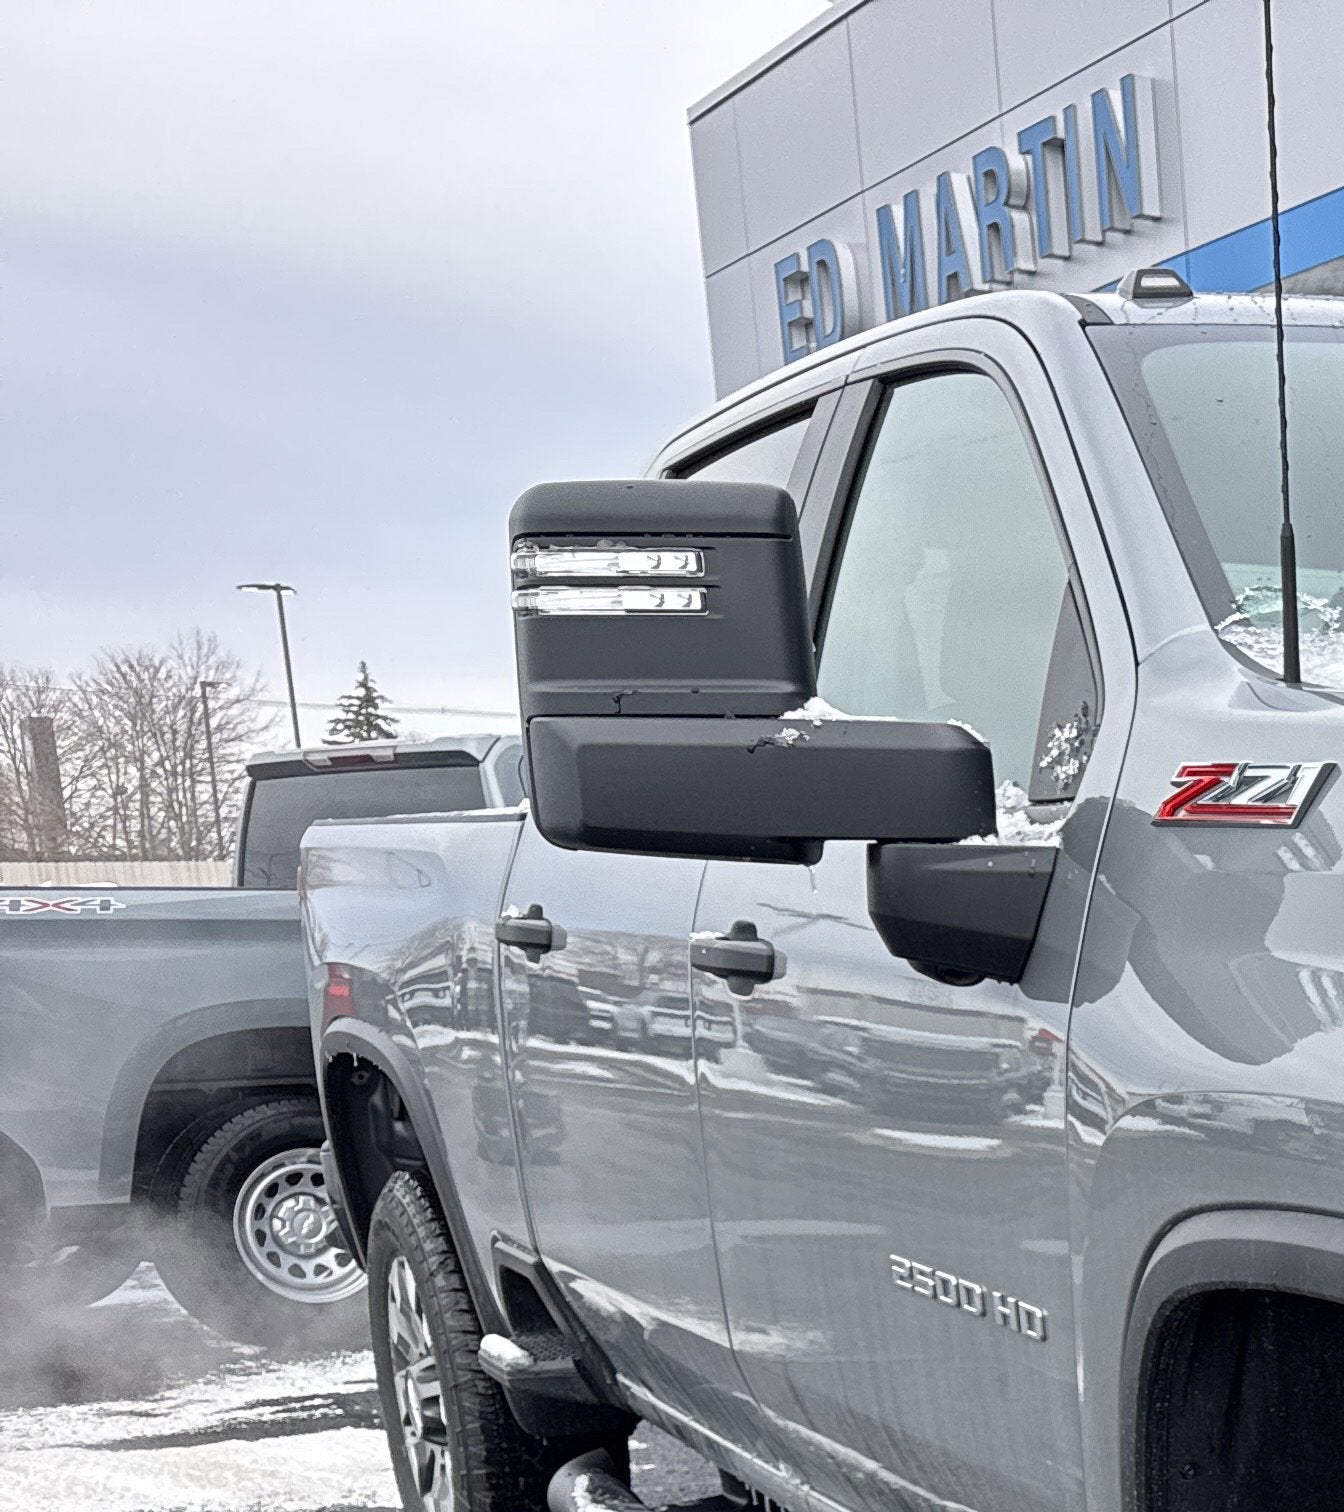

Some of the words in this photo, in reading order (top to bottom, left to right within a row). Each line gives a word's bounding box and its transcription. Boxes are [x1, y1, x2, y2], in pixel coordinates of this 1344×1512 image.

[774, 238, 846, 364] ED
[876, 73, 1150, 323] MARTIN
[1151, 761, 1341, 829] Z71
[889, 1254, 987, 1317] 2500
[992, 1291, 1048, 1342] HD
